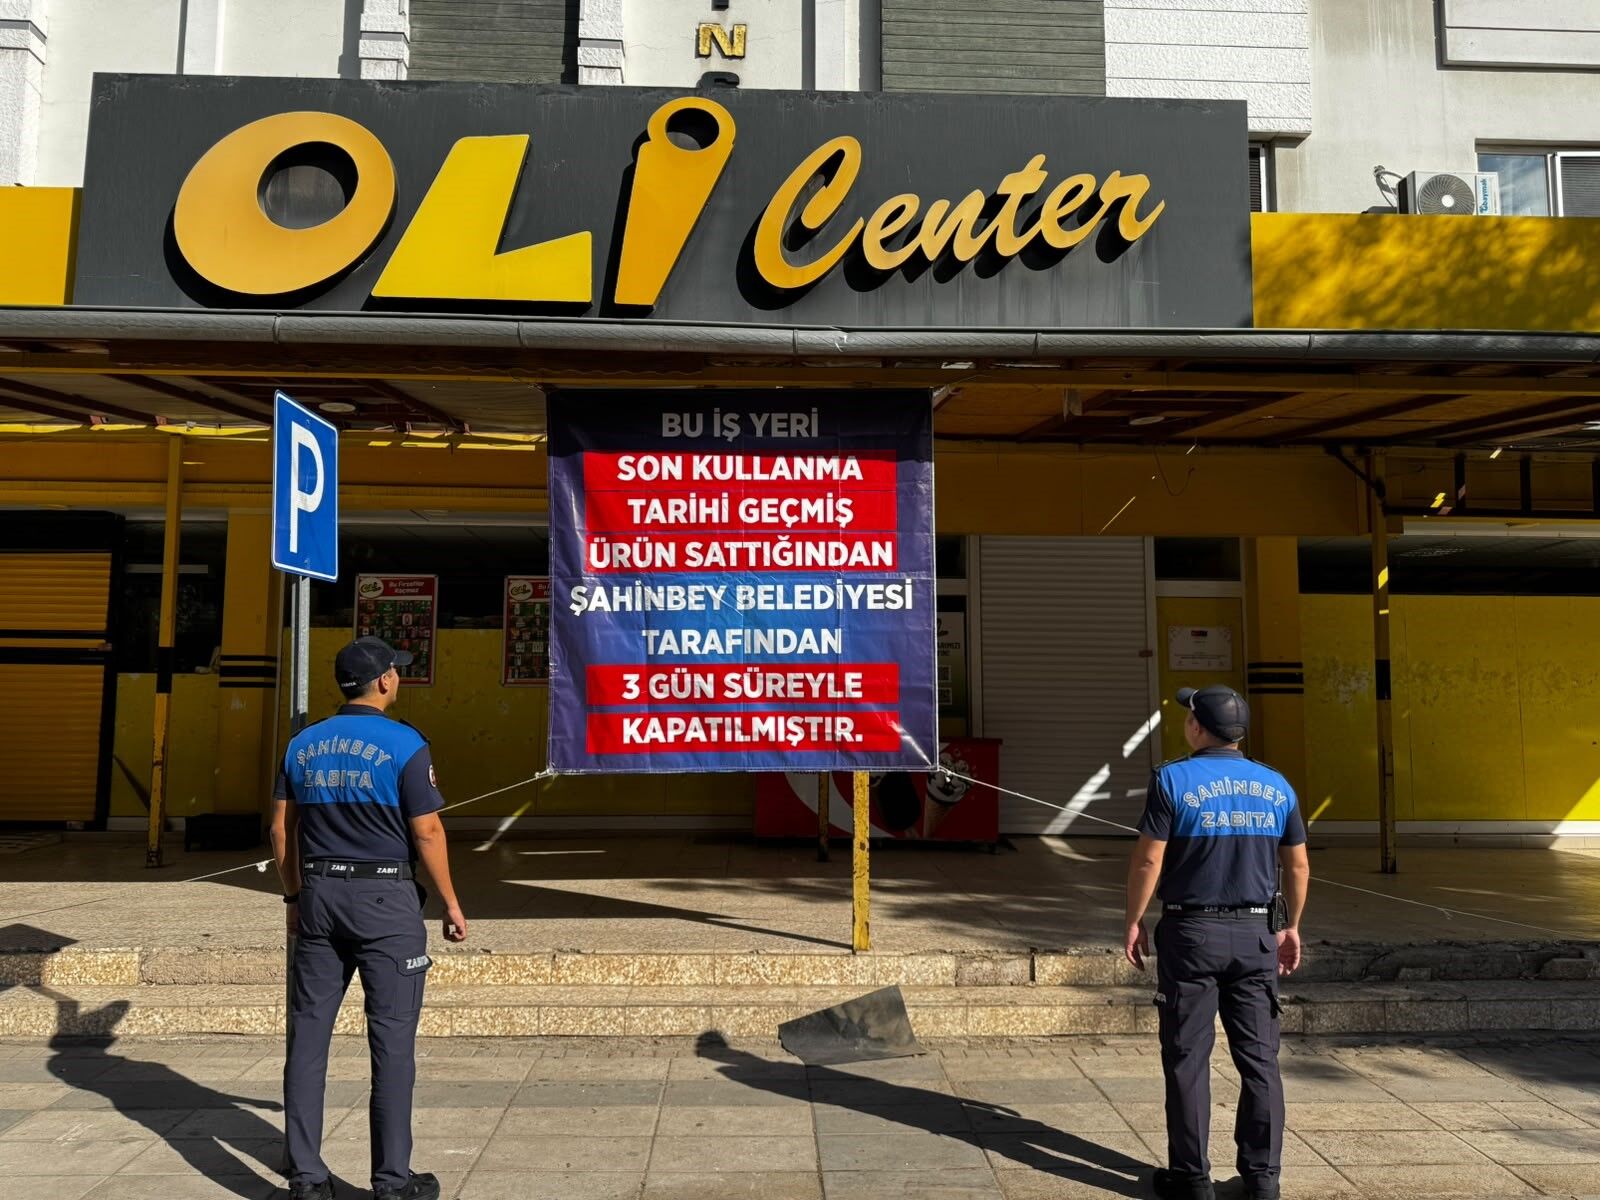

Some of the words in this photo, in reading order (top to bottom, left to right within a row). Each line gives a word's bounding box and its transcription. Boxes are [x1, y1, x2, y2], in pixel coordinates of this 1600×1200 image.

[754, 136, 1165, 289] Center
[662, 412, 703, 438] BU
[713, 407, 743, 442] İŞ
[749, 407, 819, 438] YERİ
[617, 455, 683, 481] SON
[692, 455, 863, 481] KULLANMA
[289, 420, 324, 554] P
[628, 492, 729, 524] TARİHİ
[738, 492, 854, 528] GEÇMİŞ
[589, 537, 676, 568] ÜRÜN
[685, 534, 893, 567] SATTIĞINDAN
[569, 580, 727, 617] ŞAHİNBEY
[736, 578, 913, 611] BELEDİYESİ
[642, 628, 842, 655] TARAFINDAN
[622, 673, 640, 699] 3
[649, 667, 715, 699] GÜN
[724, 666, 863, 699] SÜREYLE
[622, 716, 863, 746] KAPATILMIŞTIR.
[297, 735, 391, 768] ŞAHİNBEY
[304, 769, 373, 788] ZABITA
[1183, 776, 1287, 808] ŞAHİNBEY
[1201, 811, 1275, 828] ZABITA
[331, 864, 354, 872] ZABIA
